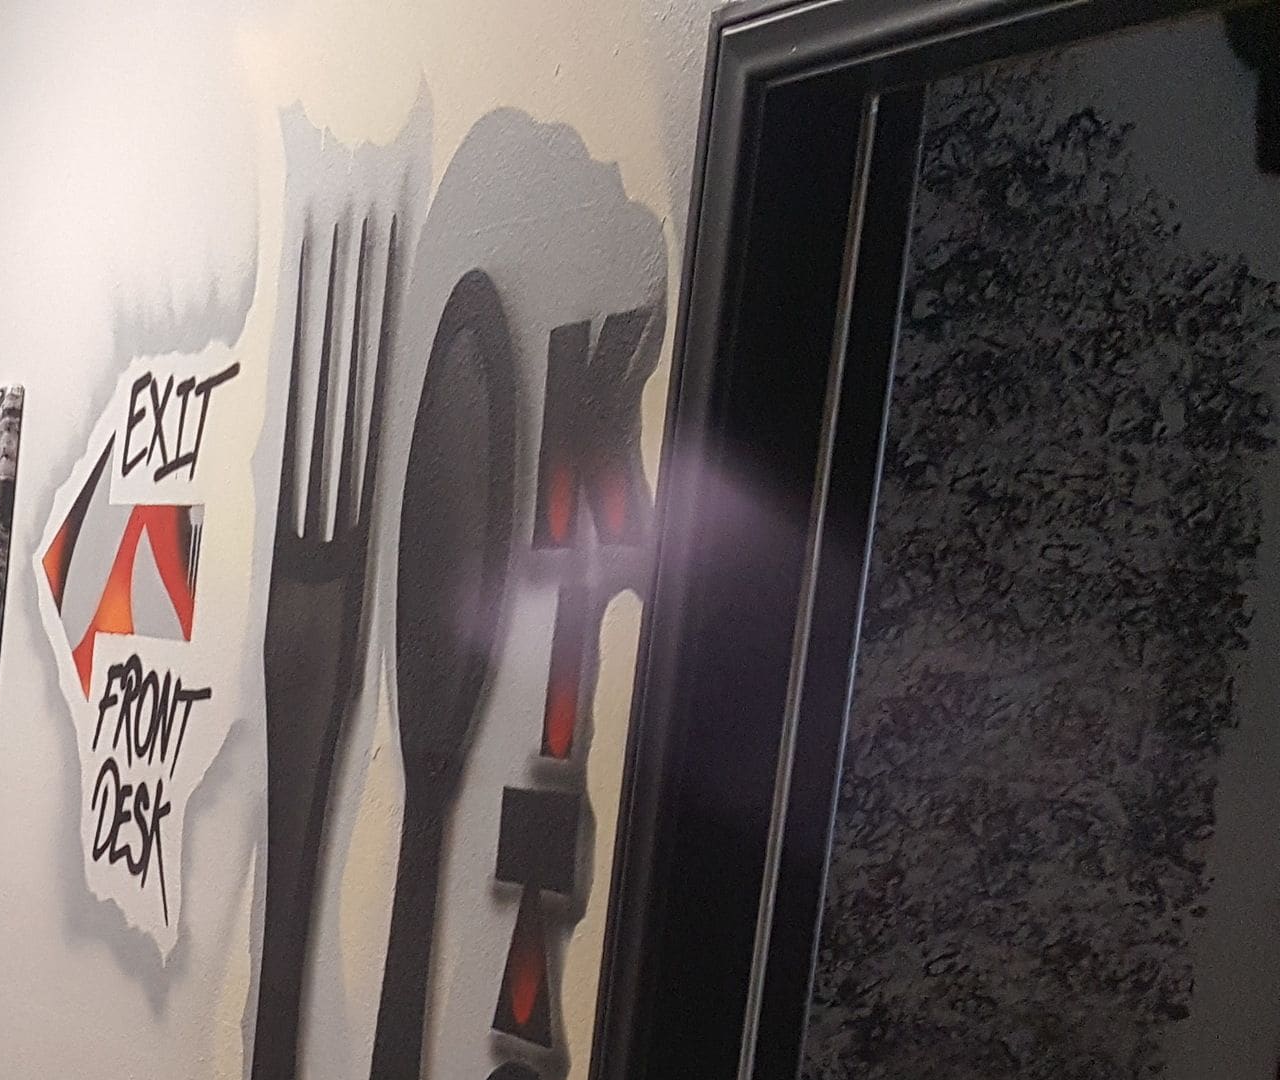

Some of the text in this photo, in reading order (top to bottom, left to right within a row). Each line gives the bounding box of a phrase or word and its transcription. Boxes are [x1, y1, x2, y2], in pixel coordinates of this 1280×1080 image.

[122, 363, 240, 482] EXIT
[92, 653, 212, 779] FRONT
[91, 757, 171, 927] DESK
